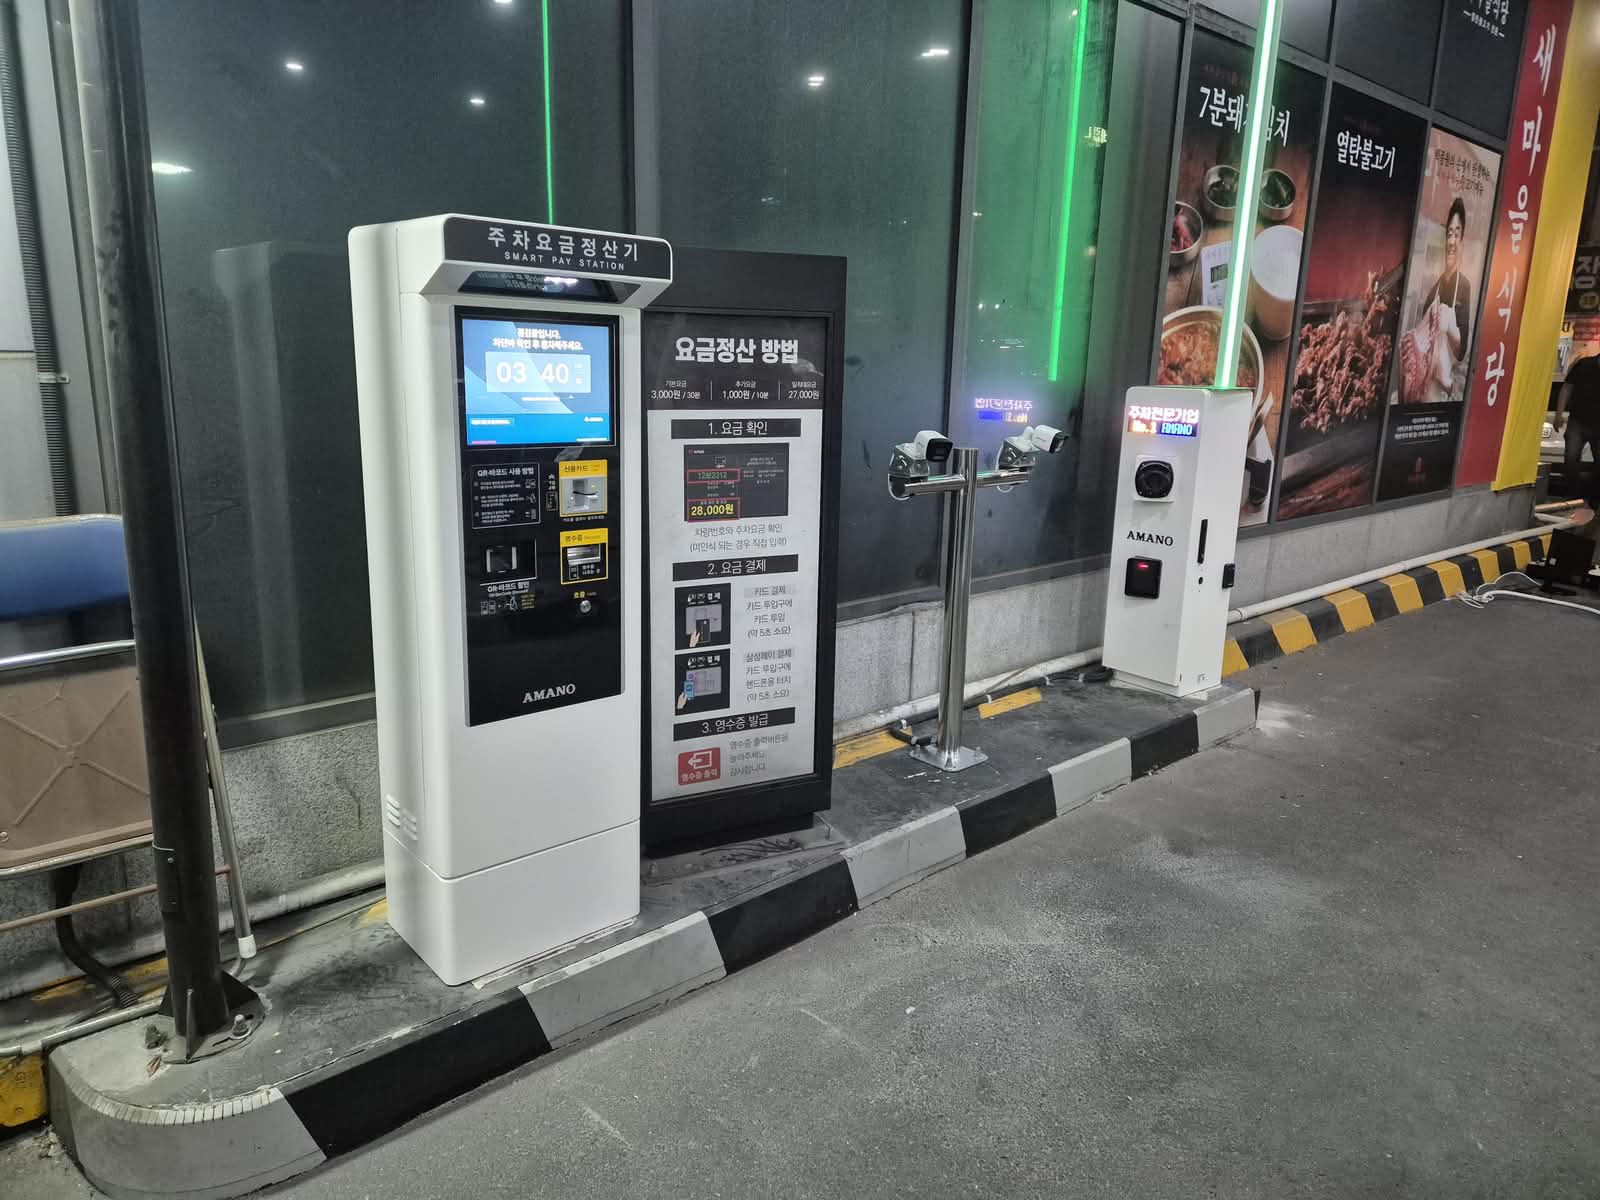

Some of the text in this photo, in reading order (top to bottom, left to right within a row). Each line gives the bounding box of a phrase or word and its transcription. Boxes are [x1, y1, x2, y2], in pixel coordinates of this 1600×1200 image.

[1200, 86, 1290, 147] 7분돼치
[1337, 129, 1396, 178] 열탄불고기
[1486, 24, 1556, 407] 새마을식당
[488, 227, 638, 262] 주차요금정산기
[504, 251, 624, 271] SMART PAY STATION
[675, 337, 799, 364] 요금정산 방법
[496, 362, 569, 384] 03 40
[788, 391, 820, 400] 27,000원
[708, 421, 768, 436] 1. 요금 확인
[1161, 422, 1193, 435] AMANO
[695, 523, 783, 538] 차량번호와 주차요금 확인
[718, 541, 733, 551] 되는
[736, 540, 751, 550] 경우
[753, 538, 768, 549] 직접
[1126, 530, 1174, 547] AMANO
[708, 559, 767, 575] 2. 요금 결제
[754, 585, 786, 596] 카드 결제
[747, 599, 793, 611] 카드 투입구에
[754, 612, 785, 624] 카드 투입
[760, 628, 772, 637] 5초
[774, 626, 791, 636] 소요)
[746, 662, 792, 675] 카드 투입구에
[522, 683, 576, 704] AMANO
[759, 691, 770, 701] 5초
[773, 689, 790, 699] 소요)
[702, 713, 769, 733] 3. 영수증 발급
[730, 739, 752, 751] 영수증
